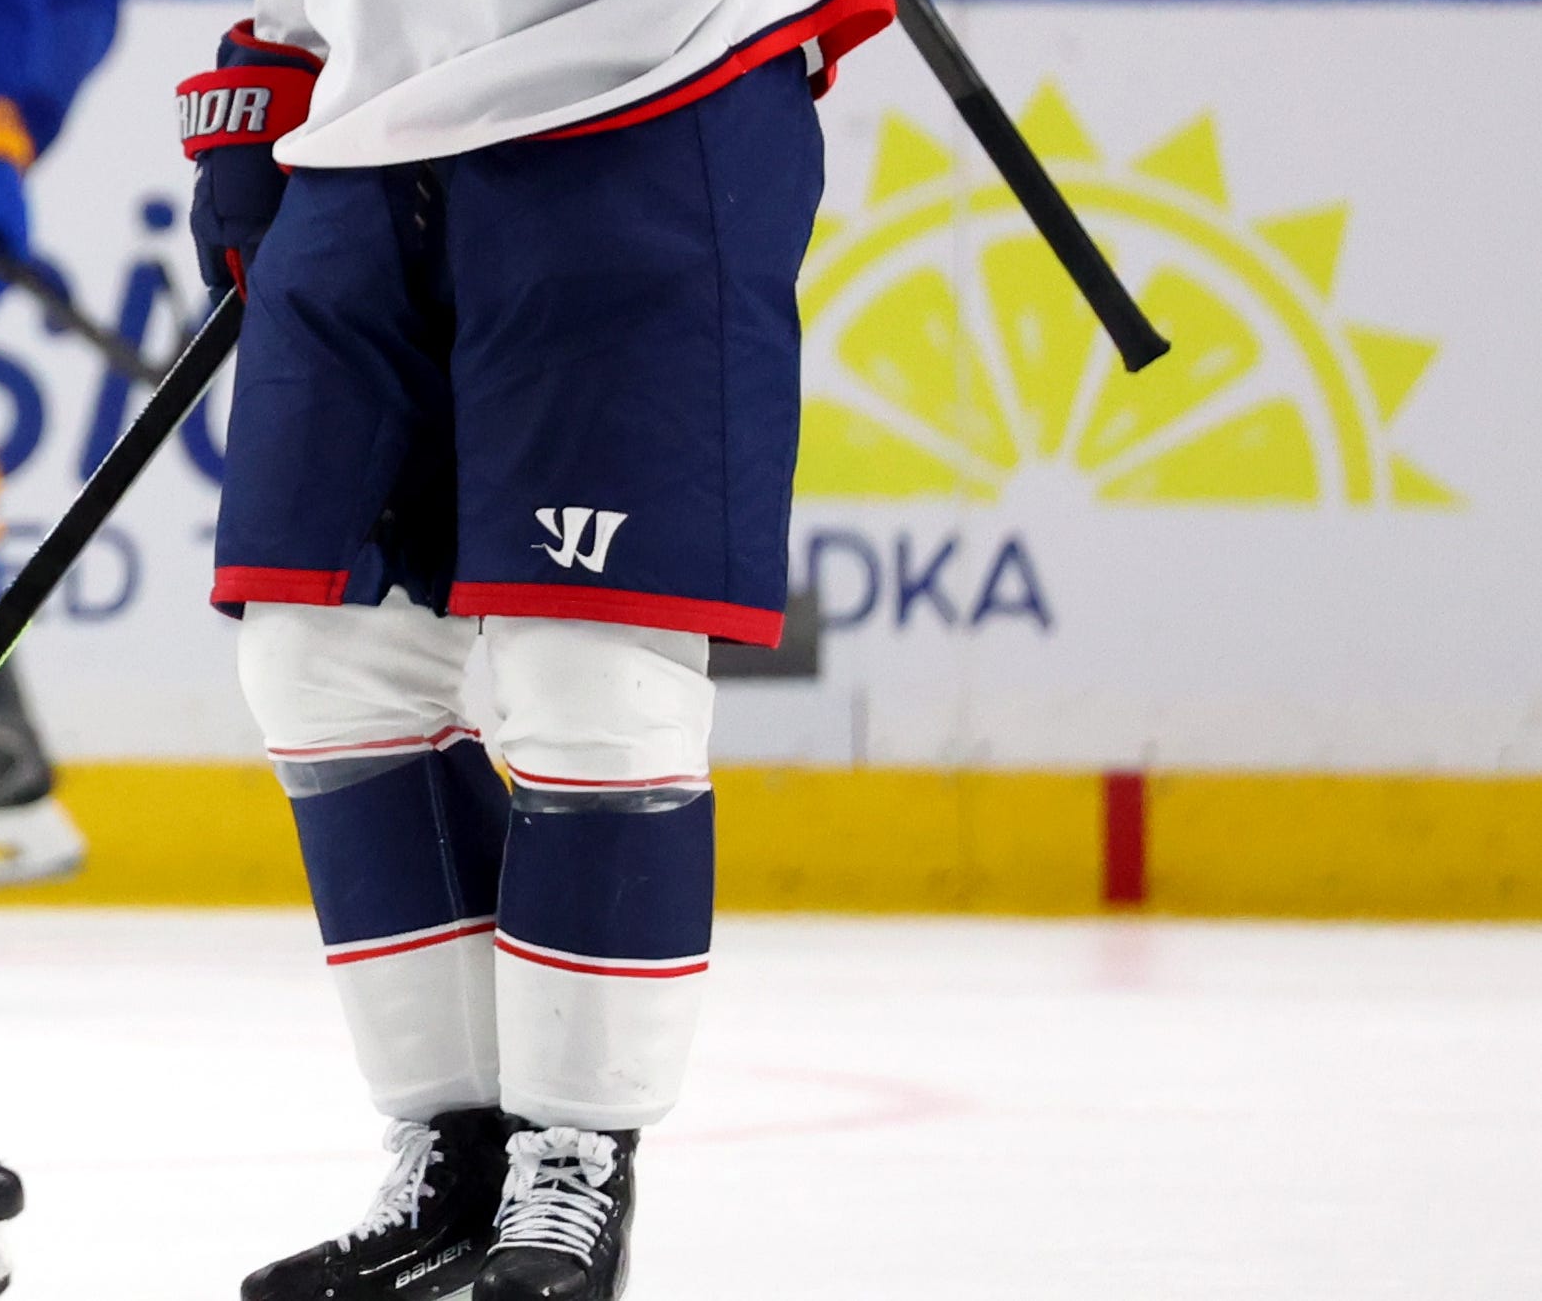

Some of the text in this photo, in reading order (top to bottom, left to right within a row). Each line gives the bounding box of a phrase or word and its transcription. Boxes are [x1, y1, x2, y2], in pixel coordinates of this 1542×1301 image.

[176, 87, 271, 140] RIOR
[805, 527, 1054, 631] DKA
[395, 1239, 472, 1290] BAUER
